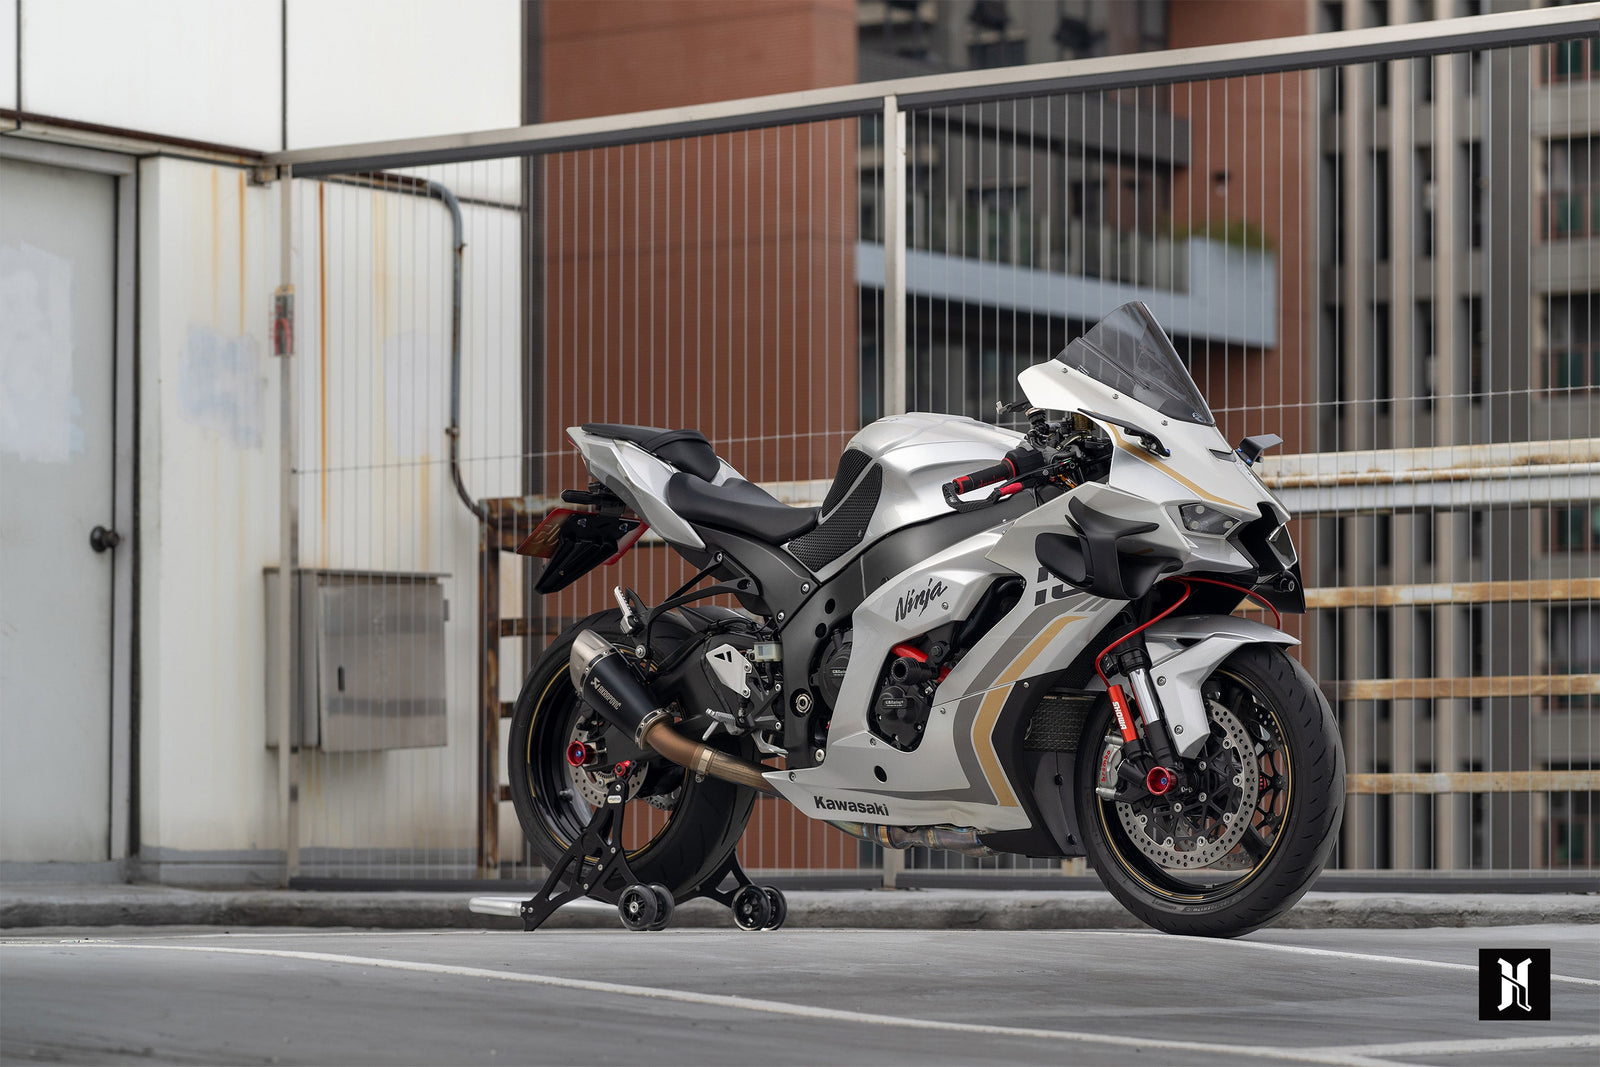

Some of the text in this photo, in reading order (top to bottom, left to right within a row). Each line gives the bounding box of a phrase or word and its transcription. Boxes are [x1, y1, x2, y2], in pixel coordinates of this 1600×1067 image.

[895, 578, 948, 622] Ninja
[1112, 701, 1127, 730] SHOWA
[1101, 750, 1111, 782] brembo
[813, 795, 890, 816] Kawasaki
